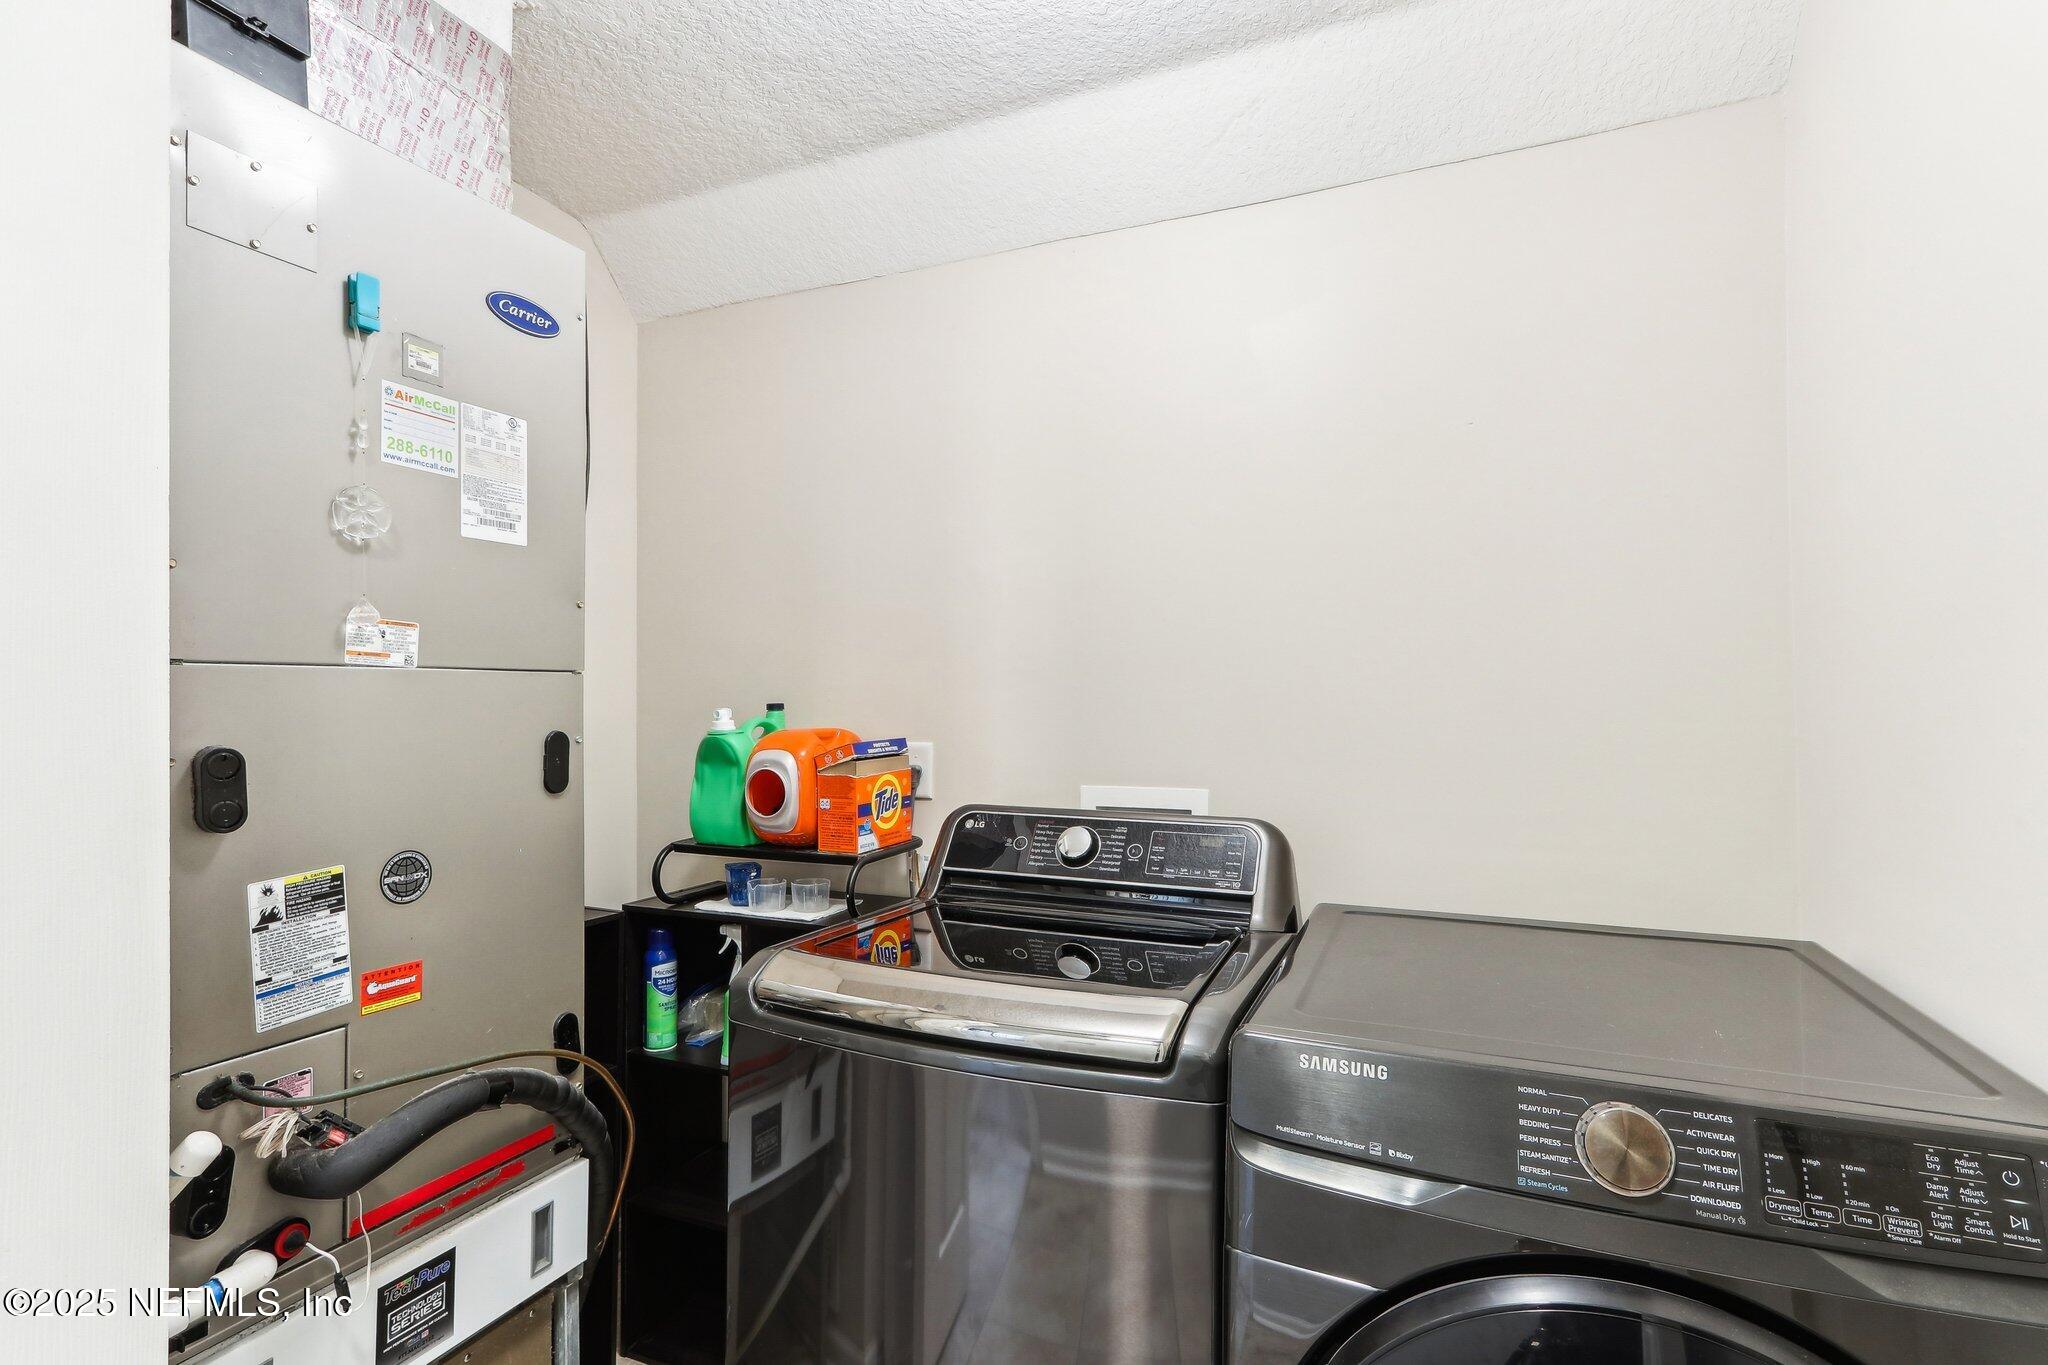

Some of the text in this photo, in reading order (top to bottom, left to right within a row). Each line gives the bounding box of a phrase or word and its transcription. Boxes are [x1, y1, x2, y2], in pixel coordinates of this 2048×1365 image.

[499, 299, 552, 329] Carrier
[394, 389, 456, 416] AirMcCall
[387, 436, 453, 463] 288-6110
[383, 452, 456, 474] www.airmccall.com
[874, 787, 899, 822] Tide
[311, 870, 332, 878] CAUTION
[364, 963, 420, 981] ATTENTION
[1299, 1053, 1388, 1080] SAMSUNG
[1518, 1086, 1548, 1096] NORMAL
[1518, 1104, 1561, 1116] HEAVY DUTY
[1693, 1111, 1733, 1124] DELICATES
[1519, 1119, 1550, 1129] BEDDING
[1519, 1134, 1562, 1147] PERM PRESS
[1686, 1129, 1735, 1142] ACTIVEWEAR
[1316, 1134, 1343, 1145] Moisture
[1343, 1139, 1366, 1151] Sensor
[1396, 1151, 1414, 1162] Bixby
[1519, 1150, 1541, 1159] STEAM
[1696, 1146, 1737, 1159] QUICK DRY
[1925, 1154, 1940, 1162] Eco
[1806, 1159, 1821, 1167] High
[1926, 1162, 1941, 1171] Dry
[1954, 1159, 1980, 1169] Adjust
[1520, 1165, 1551, 1176] REFRESH
[1702, 1163, 1738, 1176] TIME DRY
[1954, 1166, 1975, 1175] Time
[1527, 1179, 1568, 1192] Steam Cycles
[1702, 1180, 1740, 1192] AIR FLUFF
[1772, 1187, 1786, 1195] Less
[1925, 1181, 1949, 1192] Damp
[1929, 1190, 1949, 1200] Alert
[1959, 1187, 1985, 1198] Adjust
[1690, 1194, 1742, 1210] DOWNLOADED
[1959, 1195, 1980, 1205] Time
[1768, 1200, 1800, 1213] Dryness
[1890, 1205, 1900, 1213] On
[1695, 1209, 1736, 1224] Manual Dry
[1810, 1207, 1835, 1219] Temp.
[1930, 1211, 1953, 1221] Drum
[1792, 1218, 1819, 1228] Child Lock
[1852, 1214, 1873, 1225] Time
[1887, 1216, 1918, 1229] Wrinkle
[1932, 1220, 1954, 1230] Light
[1965, 1217, 1991, 1228] Smart
[1888, 1224, 1920, 1236] Prevent
[1964, 1225, 1995, 1237] Control
[1891, 1235, 1922, 1245] Smart Care
[1933, 1234, 1961, 1244] Alarm Off
[2002, 1232, 2017, 1240] Hold
[2025, 1235, 2042, 1244] Start
[384, 1260, 451, 1306] TechPure
[391, 1289, 443, 1324] TECHNOLOGY
[391, 1298, 442, 1335] SERIES
